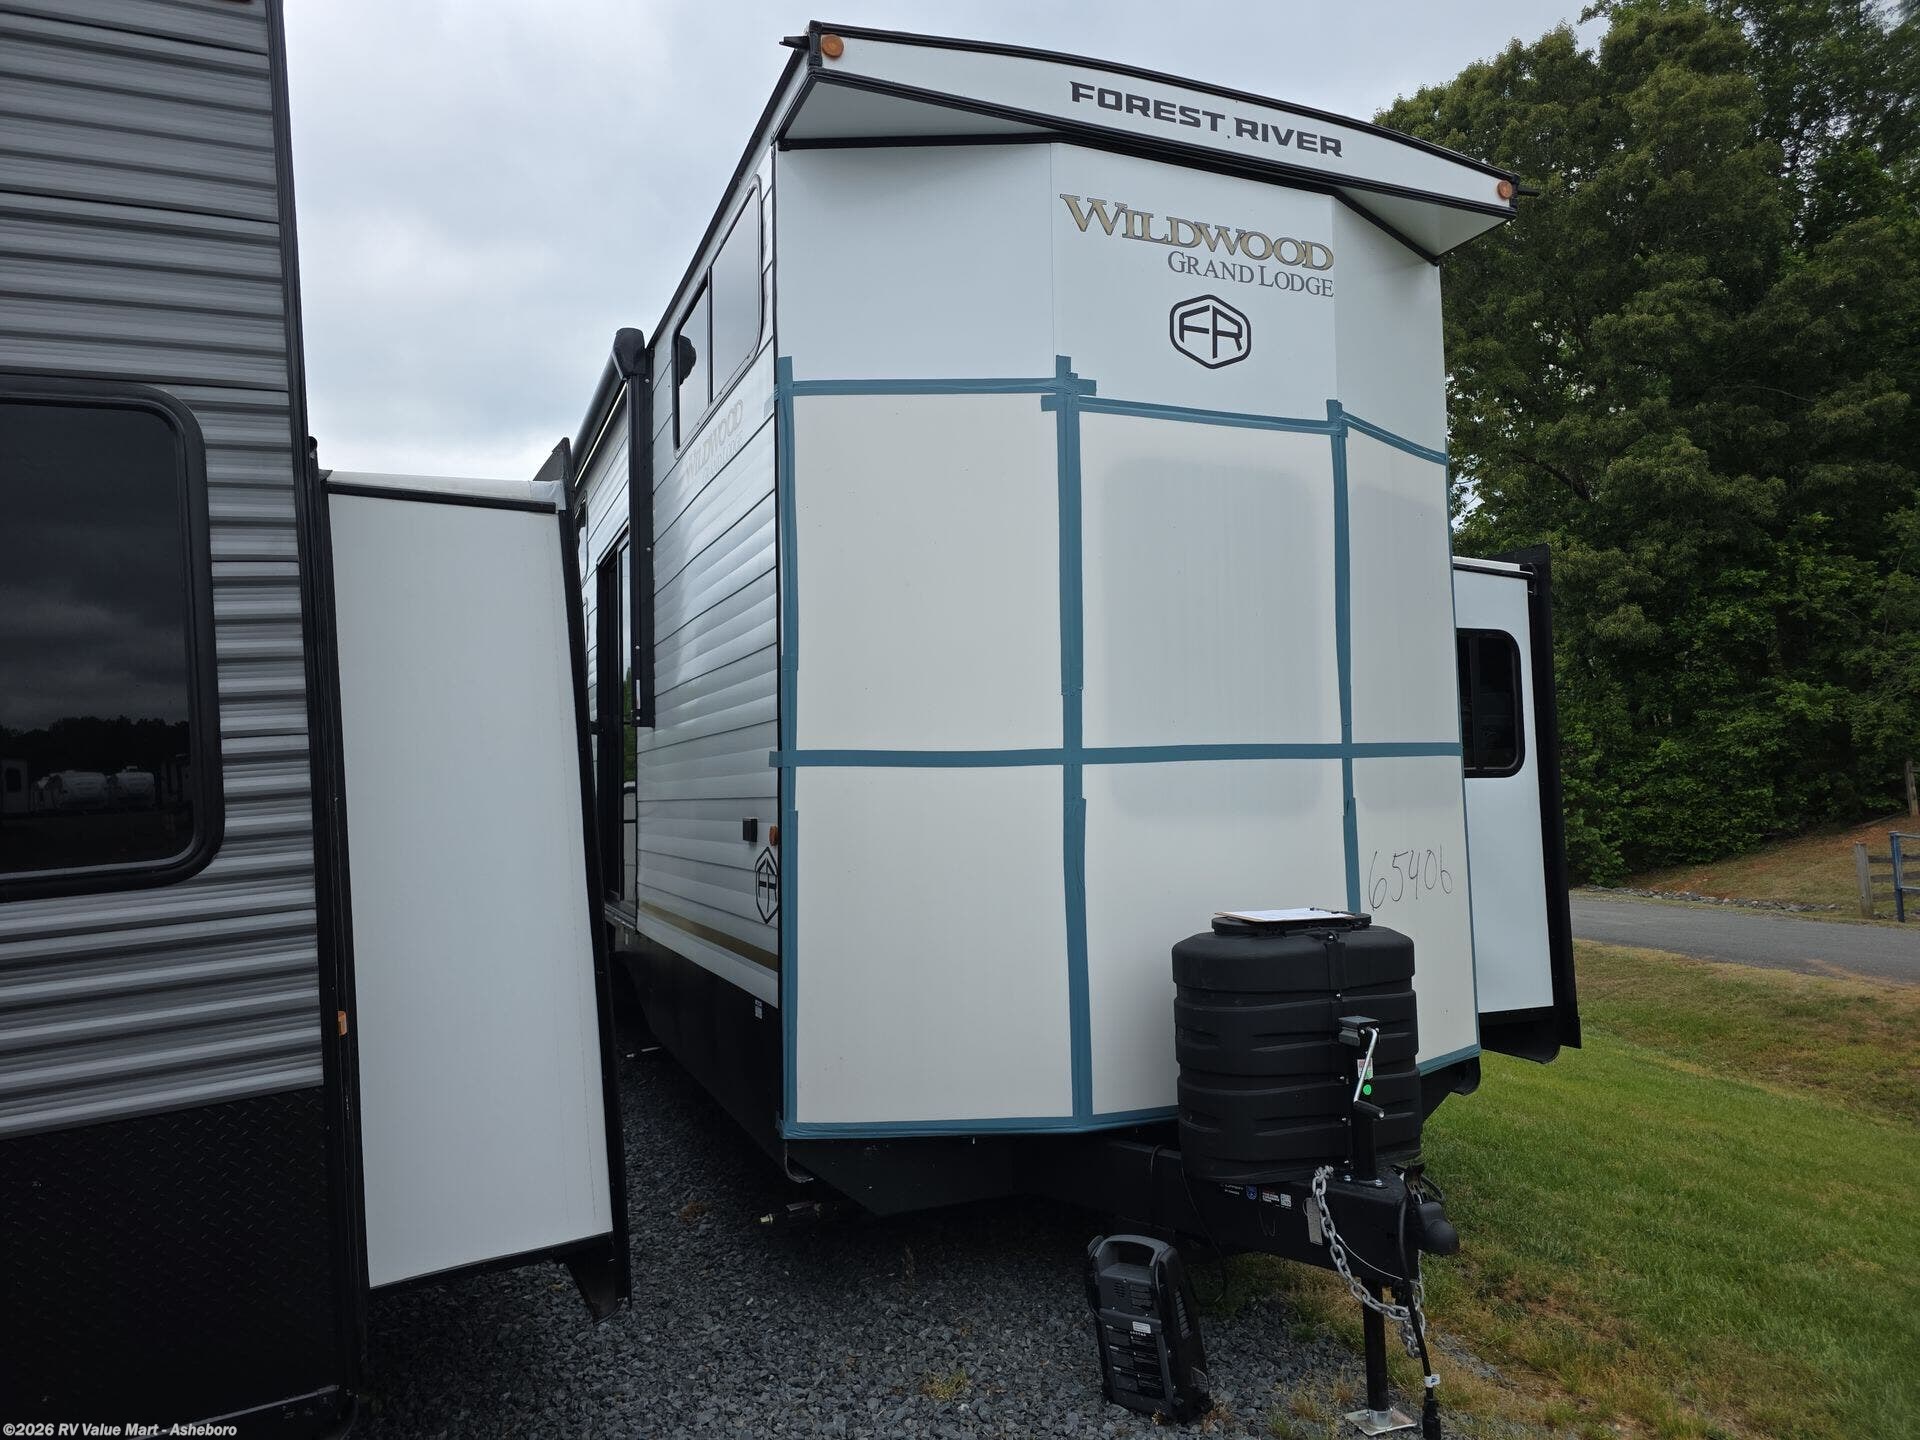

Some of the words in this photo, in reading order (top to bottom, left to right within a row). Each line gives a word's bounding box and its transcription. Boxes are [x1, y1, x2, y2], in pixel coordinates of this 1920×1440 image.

[1069, 80, 1226, 133] FOREST
[1233, 116, 1343, 158] RIVER
[1059, 193, 1335, 272] WILDWOOD
[1167, 250, 1255, 284] GRAND
[1258, 264, 1335, 298] LODGE
[1178, 304, 1243, 359] FR
[1368, 843, 1453, 912] 65406
